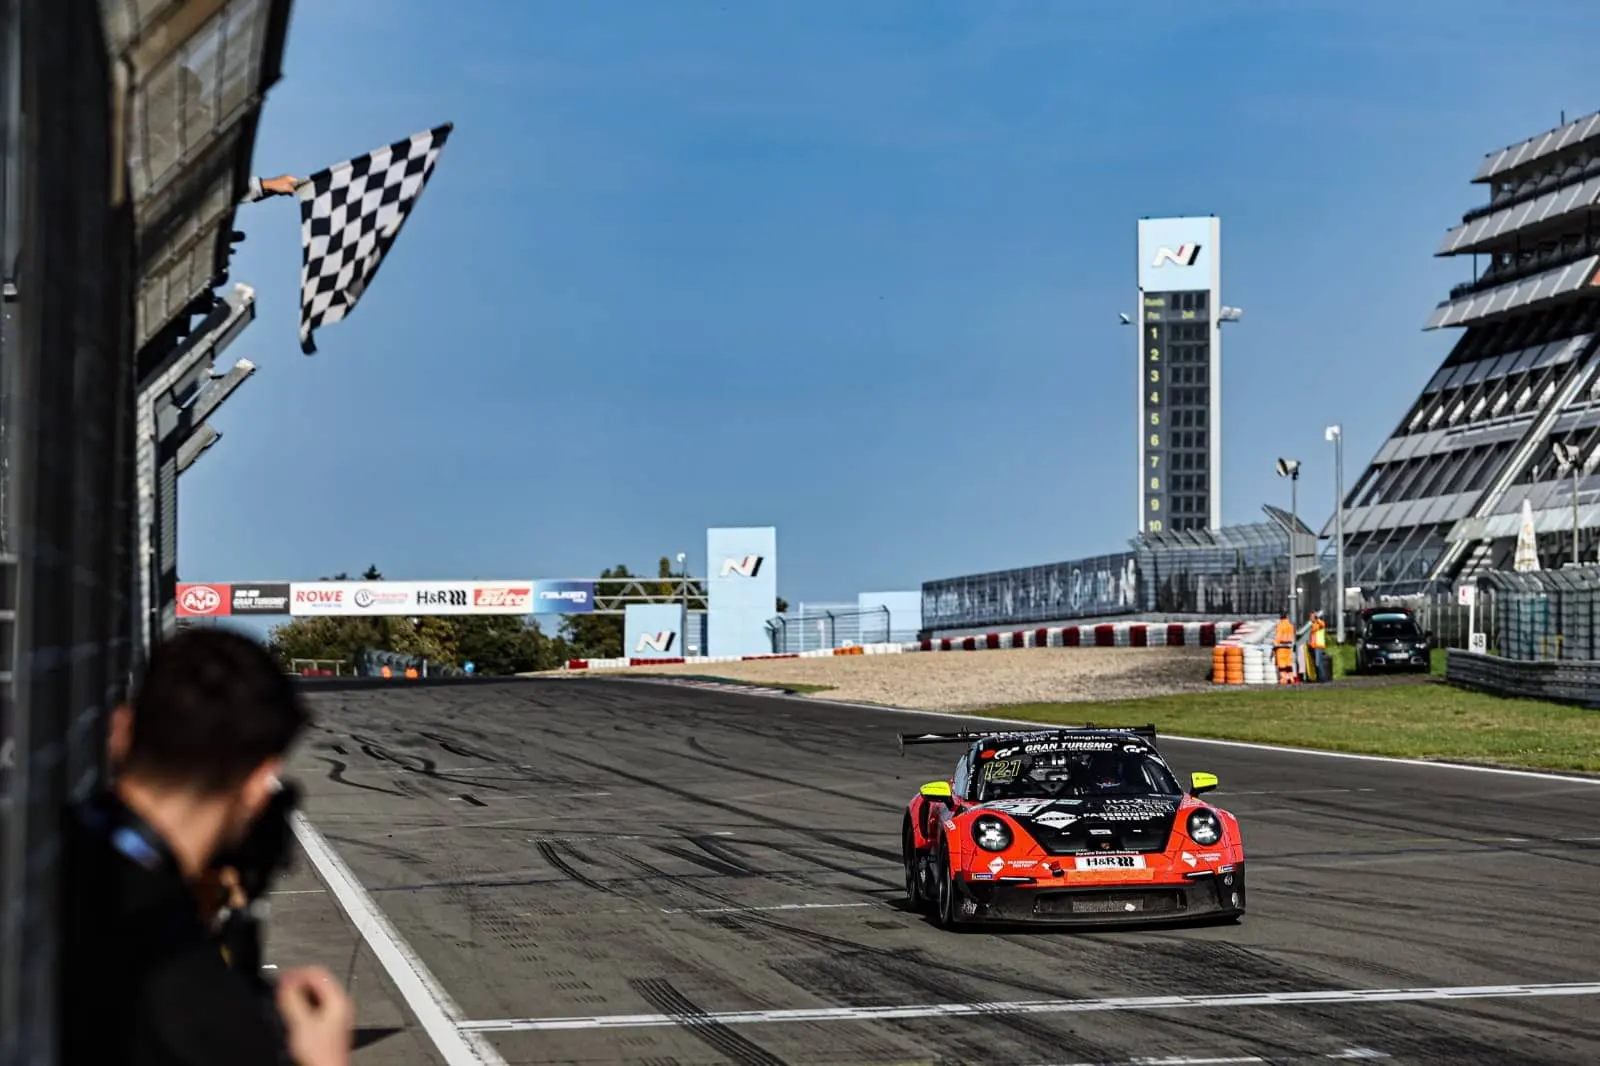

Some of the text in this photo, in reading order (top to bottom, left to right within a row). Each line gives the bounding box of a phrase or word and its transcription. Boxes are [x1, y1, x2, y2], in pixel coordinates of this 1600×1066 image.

[1150, 327, 1158, 340] 1
[1150, 348, 1160, 361] 2
[1150, 370, 1160, 382] 3
[1150, 391, 1160, 404] 4
[1150, 412, 1160, 425] 5
[1150, 434, 1160, 447] 6
[1150, 456, 1160, 468] 7
[1150, 477, 1160, 489] 8
[1150, 498, 1160, 511] 9
[1148, 520, 1162, 532] 10
[295, 590, 343, 602] ROWE
[416, 590, 447, 606] H&R
[1473, 636, 1484, 648] 48
[1025, 743, 1058, 753] GRAN
[983, 759, 1021, 780] 121
[1086, 857, 1116, 867] H&R
